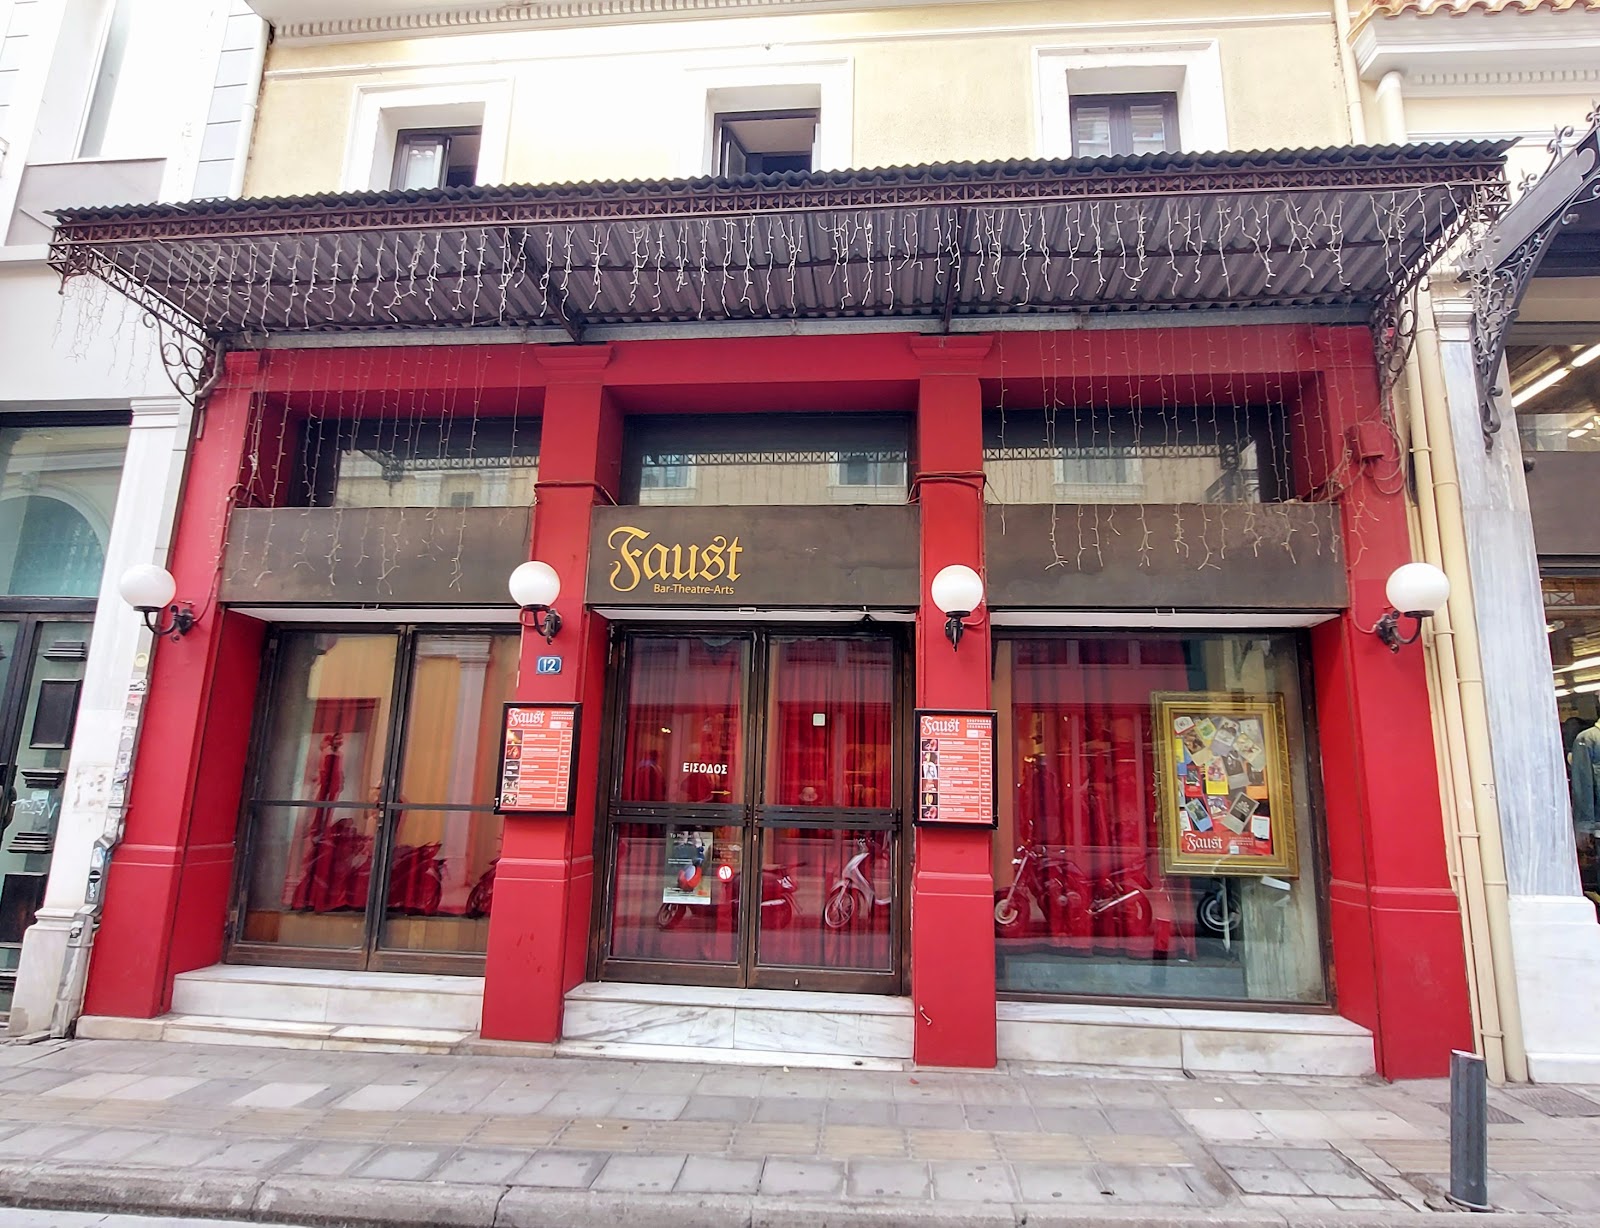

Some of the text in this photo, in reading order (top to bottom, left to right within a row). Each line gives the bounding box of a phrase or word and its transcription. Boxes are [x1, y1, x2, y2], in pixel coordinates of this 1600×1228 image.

[607, 526, 743, 592] Faust
[653, 583, 735, 595] Bar-Theatre-Arts
[543, 658, 556, 671] 12
[508, 707, 545, 727] Faust
[920, 715, 960, 736] Faust
[682, 762, 728, 775] ΕΙΣΟΔΟΣ
[1184, 832, 1223, 852] Faust
